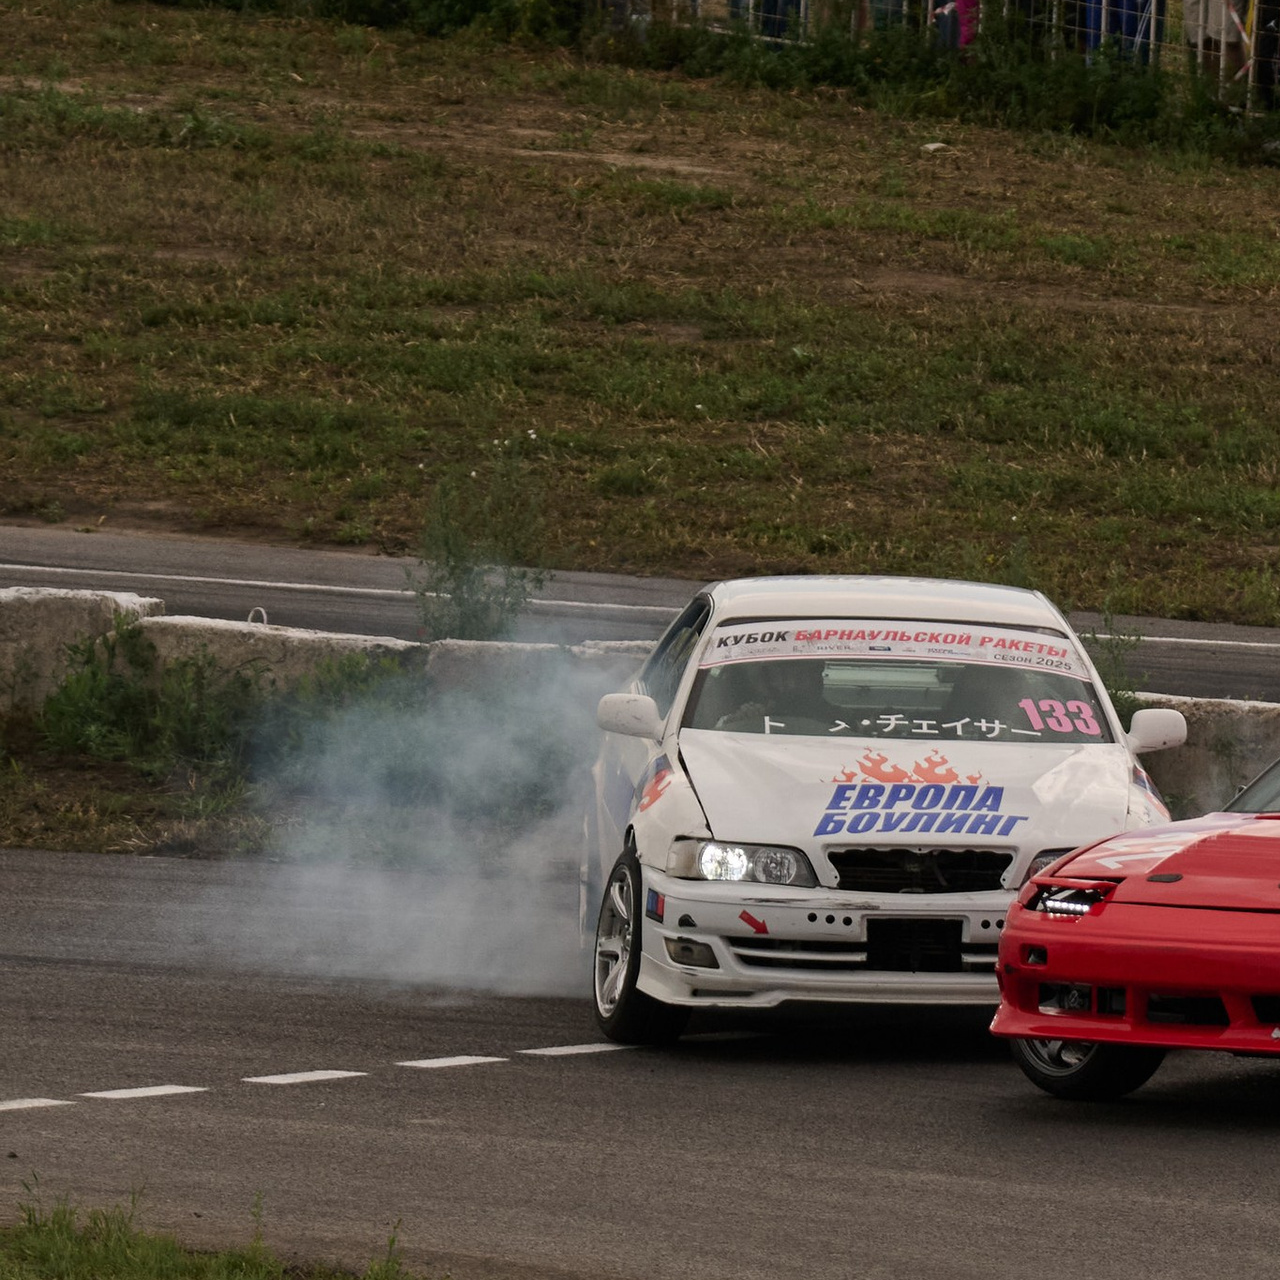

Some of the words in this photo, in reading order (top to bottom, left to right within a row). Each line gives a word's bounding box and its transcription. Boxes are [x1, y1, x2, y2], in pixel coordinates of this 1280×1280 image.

[716, 630, 790, 649] КУБОК
[794, 629, 972, 646] БАРНАУЛЬСКОЙ
[979, 635, 1069, 659] РАКЕТЫ
[993, 653, 1032, 664] СЕЗОН
[1035, 656, 1073, 671] 2025
[1018, 698, 1101, 736] 133
[825, 784, 1004, 812] ЕВРОПА
[813, 811, 1029, 837] БОУЛИНГ
